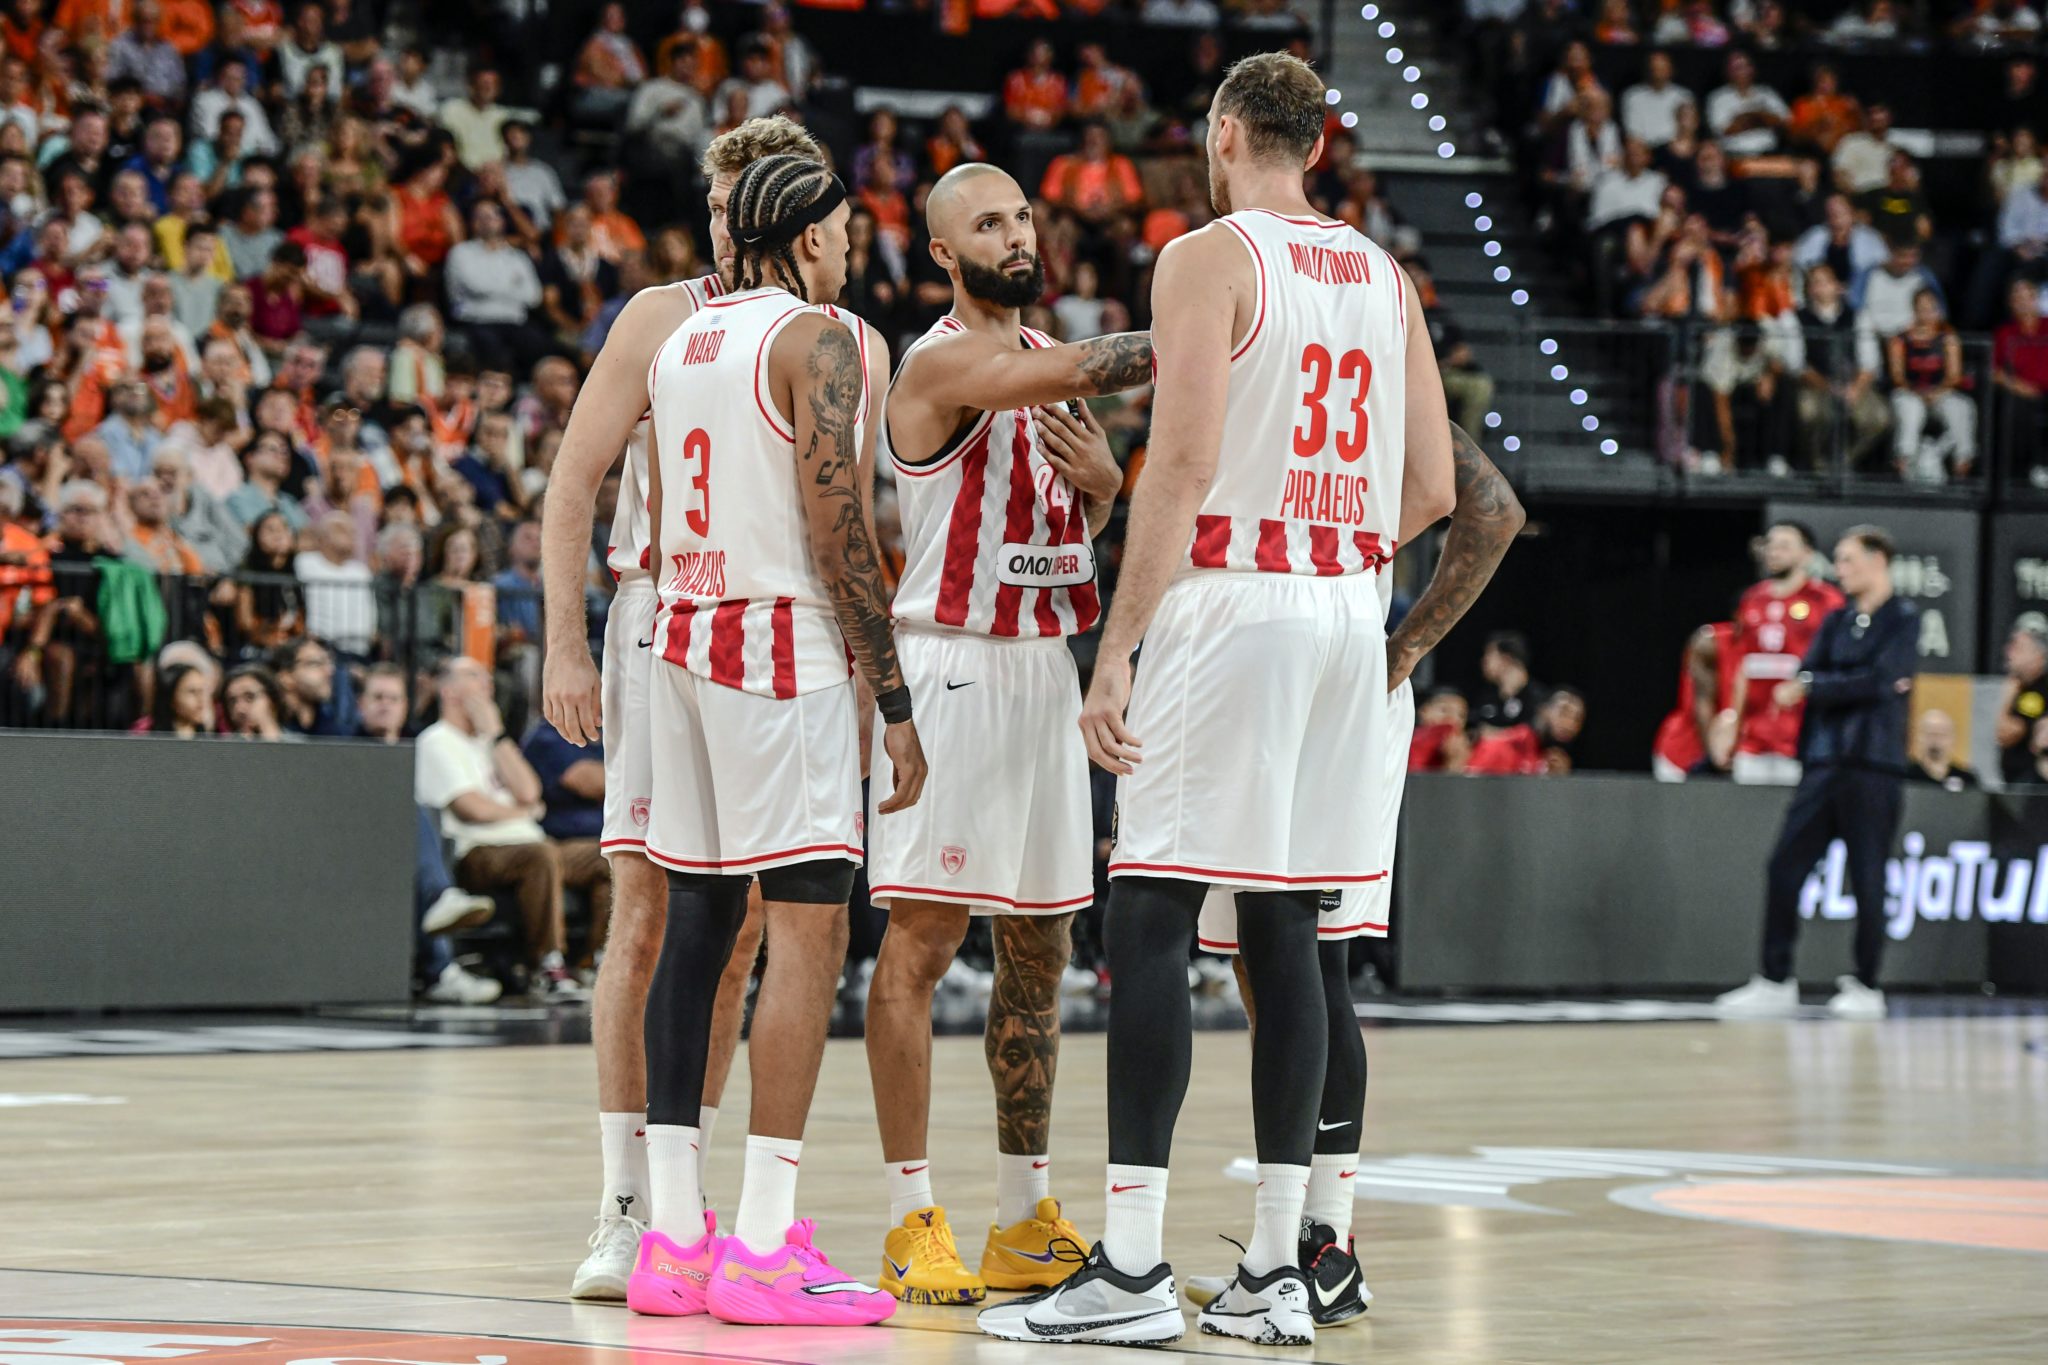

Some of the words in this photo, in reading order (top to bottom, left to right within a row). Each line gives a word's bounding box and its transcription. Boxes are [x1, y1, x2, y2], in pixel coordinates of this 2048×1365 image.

[1287, 242, 1371, 285] MILUTINOV
[683, 330, 726, 365] WARD
[1293, 343, 1373, 463] 33
[683, 428, 711, 538] 3
[1280, 469, 1368, 525] PIRAEUS
[668, 550, 726, 598] PIRAEUS
[1281, 1282, 1297, 1291] NIKE
